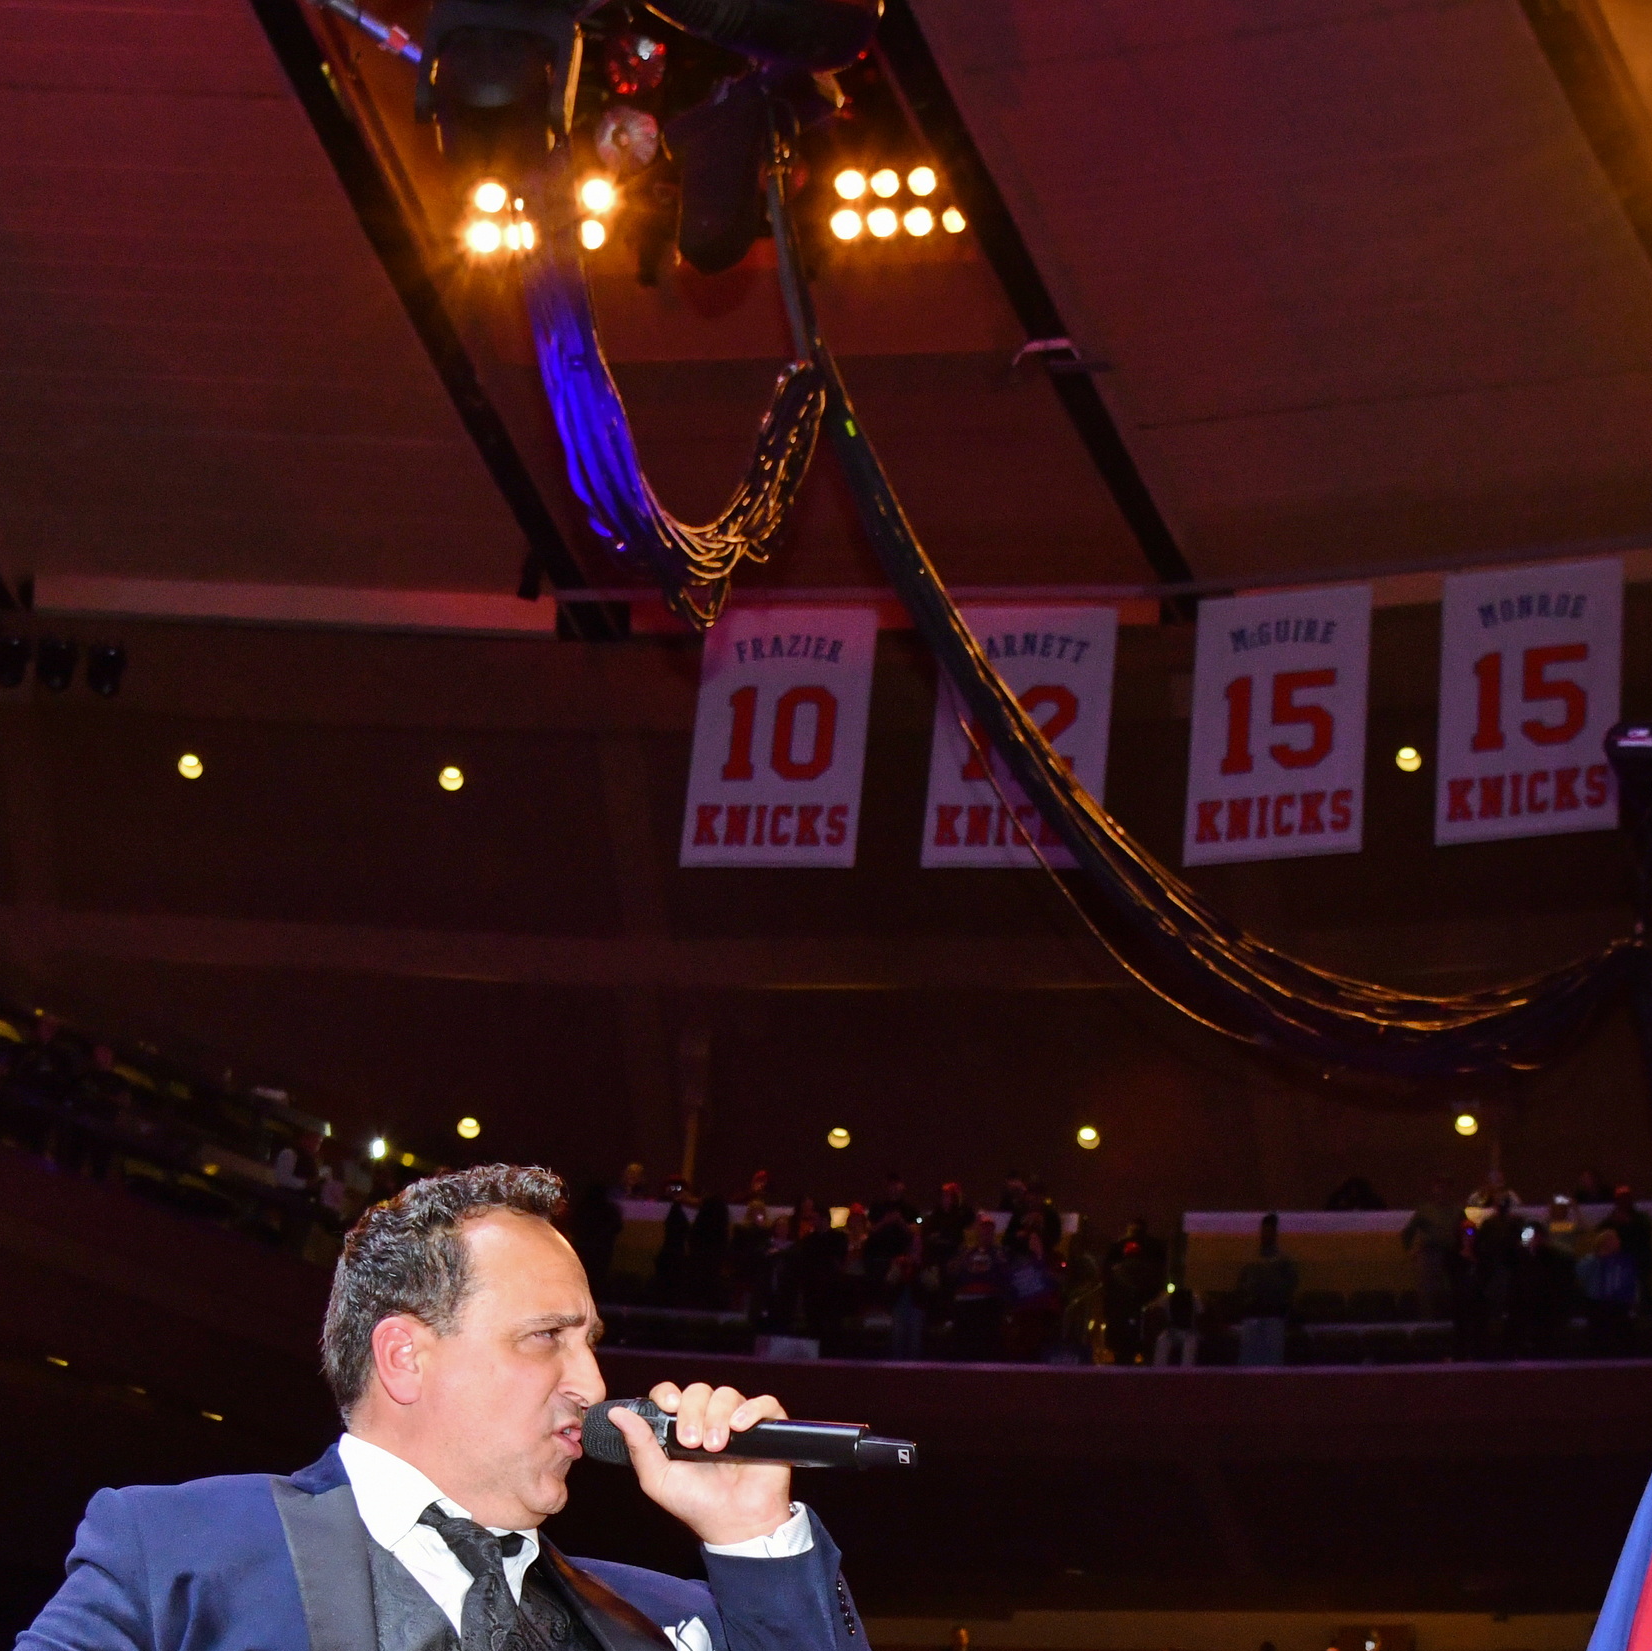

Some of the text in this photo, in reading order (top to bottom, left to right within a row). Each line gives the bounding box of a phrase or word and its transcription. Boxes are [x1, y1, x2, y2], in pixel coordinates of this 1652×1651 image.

[1478, 594, 1587, 628] MONROE
[735, 634, 843, 664] FRAZIER
[985, 632, 1091, 663] ARNETT
[1220, 669, 1337, 775] 15
[1471, 644, 1589, 753] 15
[722, 685, 838, 781] 10
[1195, 790, 1353, 844] KNICKS
[1447, 765, 1608, 822] KNICKS
[693, 804, 849, 847] KNICKS
